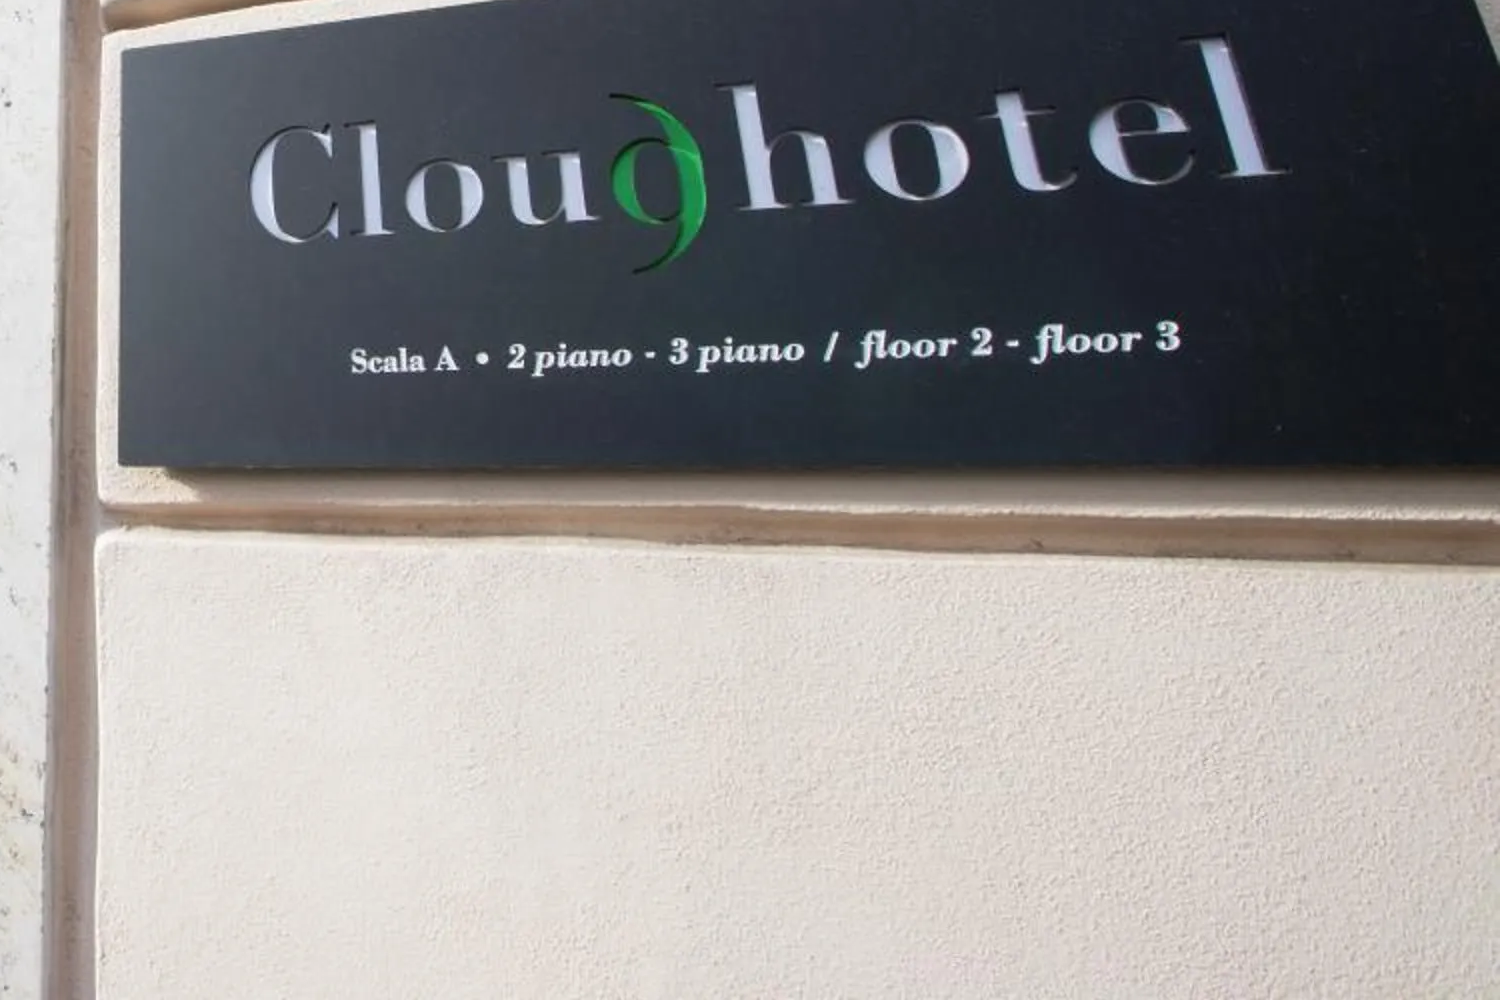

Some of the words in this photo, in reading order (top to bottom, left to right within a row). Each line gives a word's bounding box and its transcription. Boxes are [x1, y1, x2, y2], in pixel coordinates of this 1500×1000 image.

[350, 346, 426, 374] Scala
[434, 345, 460, 371] A
[507, 343, 526, 369] 2
[531, 343, 633, 376] piano
[668, 337, 689, 365] 3
[695, 337, 805, 373] piano
[823, 331, 840, 362] /
[855, 328, 958, 369] floor
[969, 327, 994, 357] 2
[1030, 323, 1143, 365] floor
[1156, 320, 1181, 351] 3
